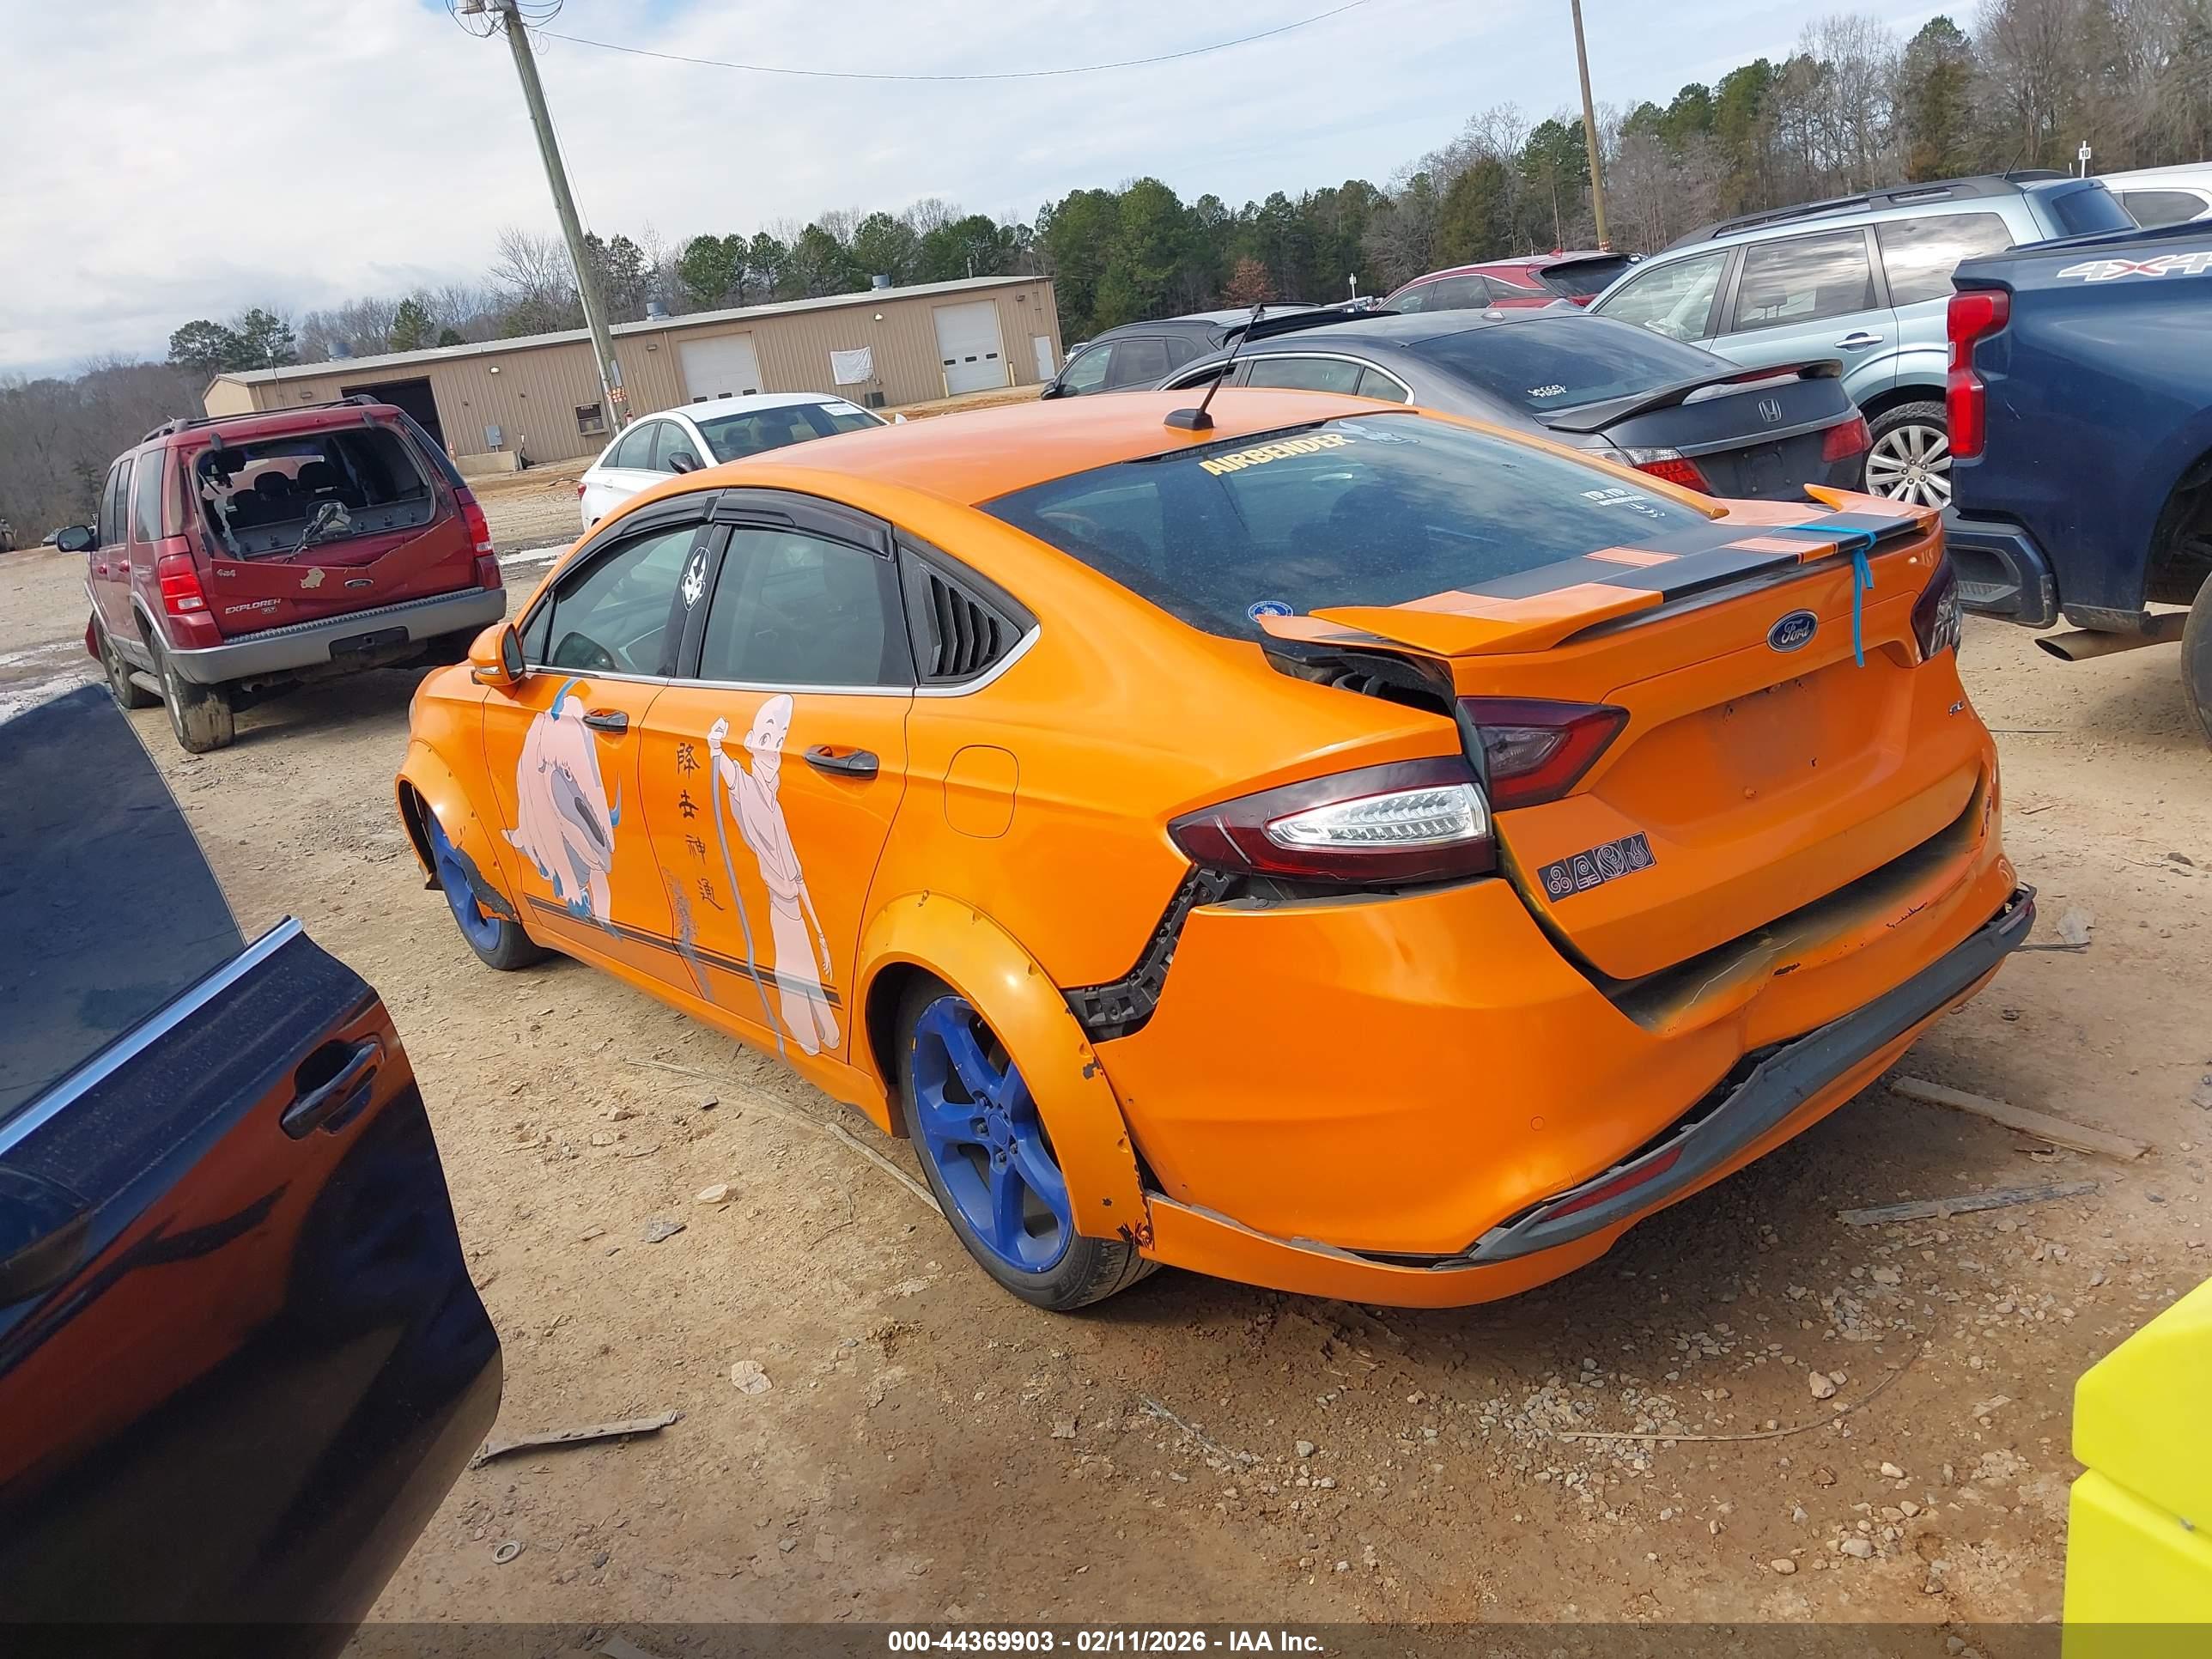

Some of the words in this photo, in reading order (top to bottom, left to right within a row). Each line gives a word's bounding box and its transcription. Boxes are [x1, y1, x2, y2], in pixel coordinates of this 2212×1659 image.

[2081, 149, 2089, 158] 10
[1198, 434, 1356, 476] AIRBENDER
[225, 599, 282, 615] EXPLORER
[1782, 619, 1810, 643] Ford
